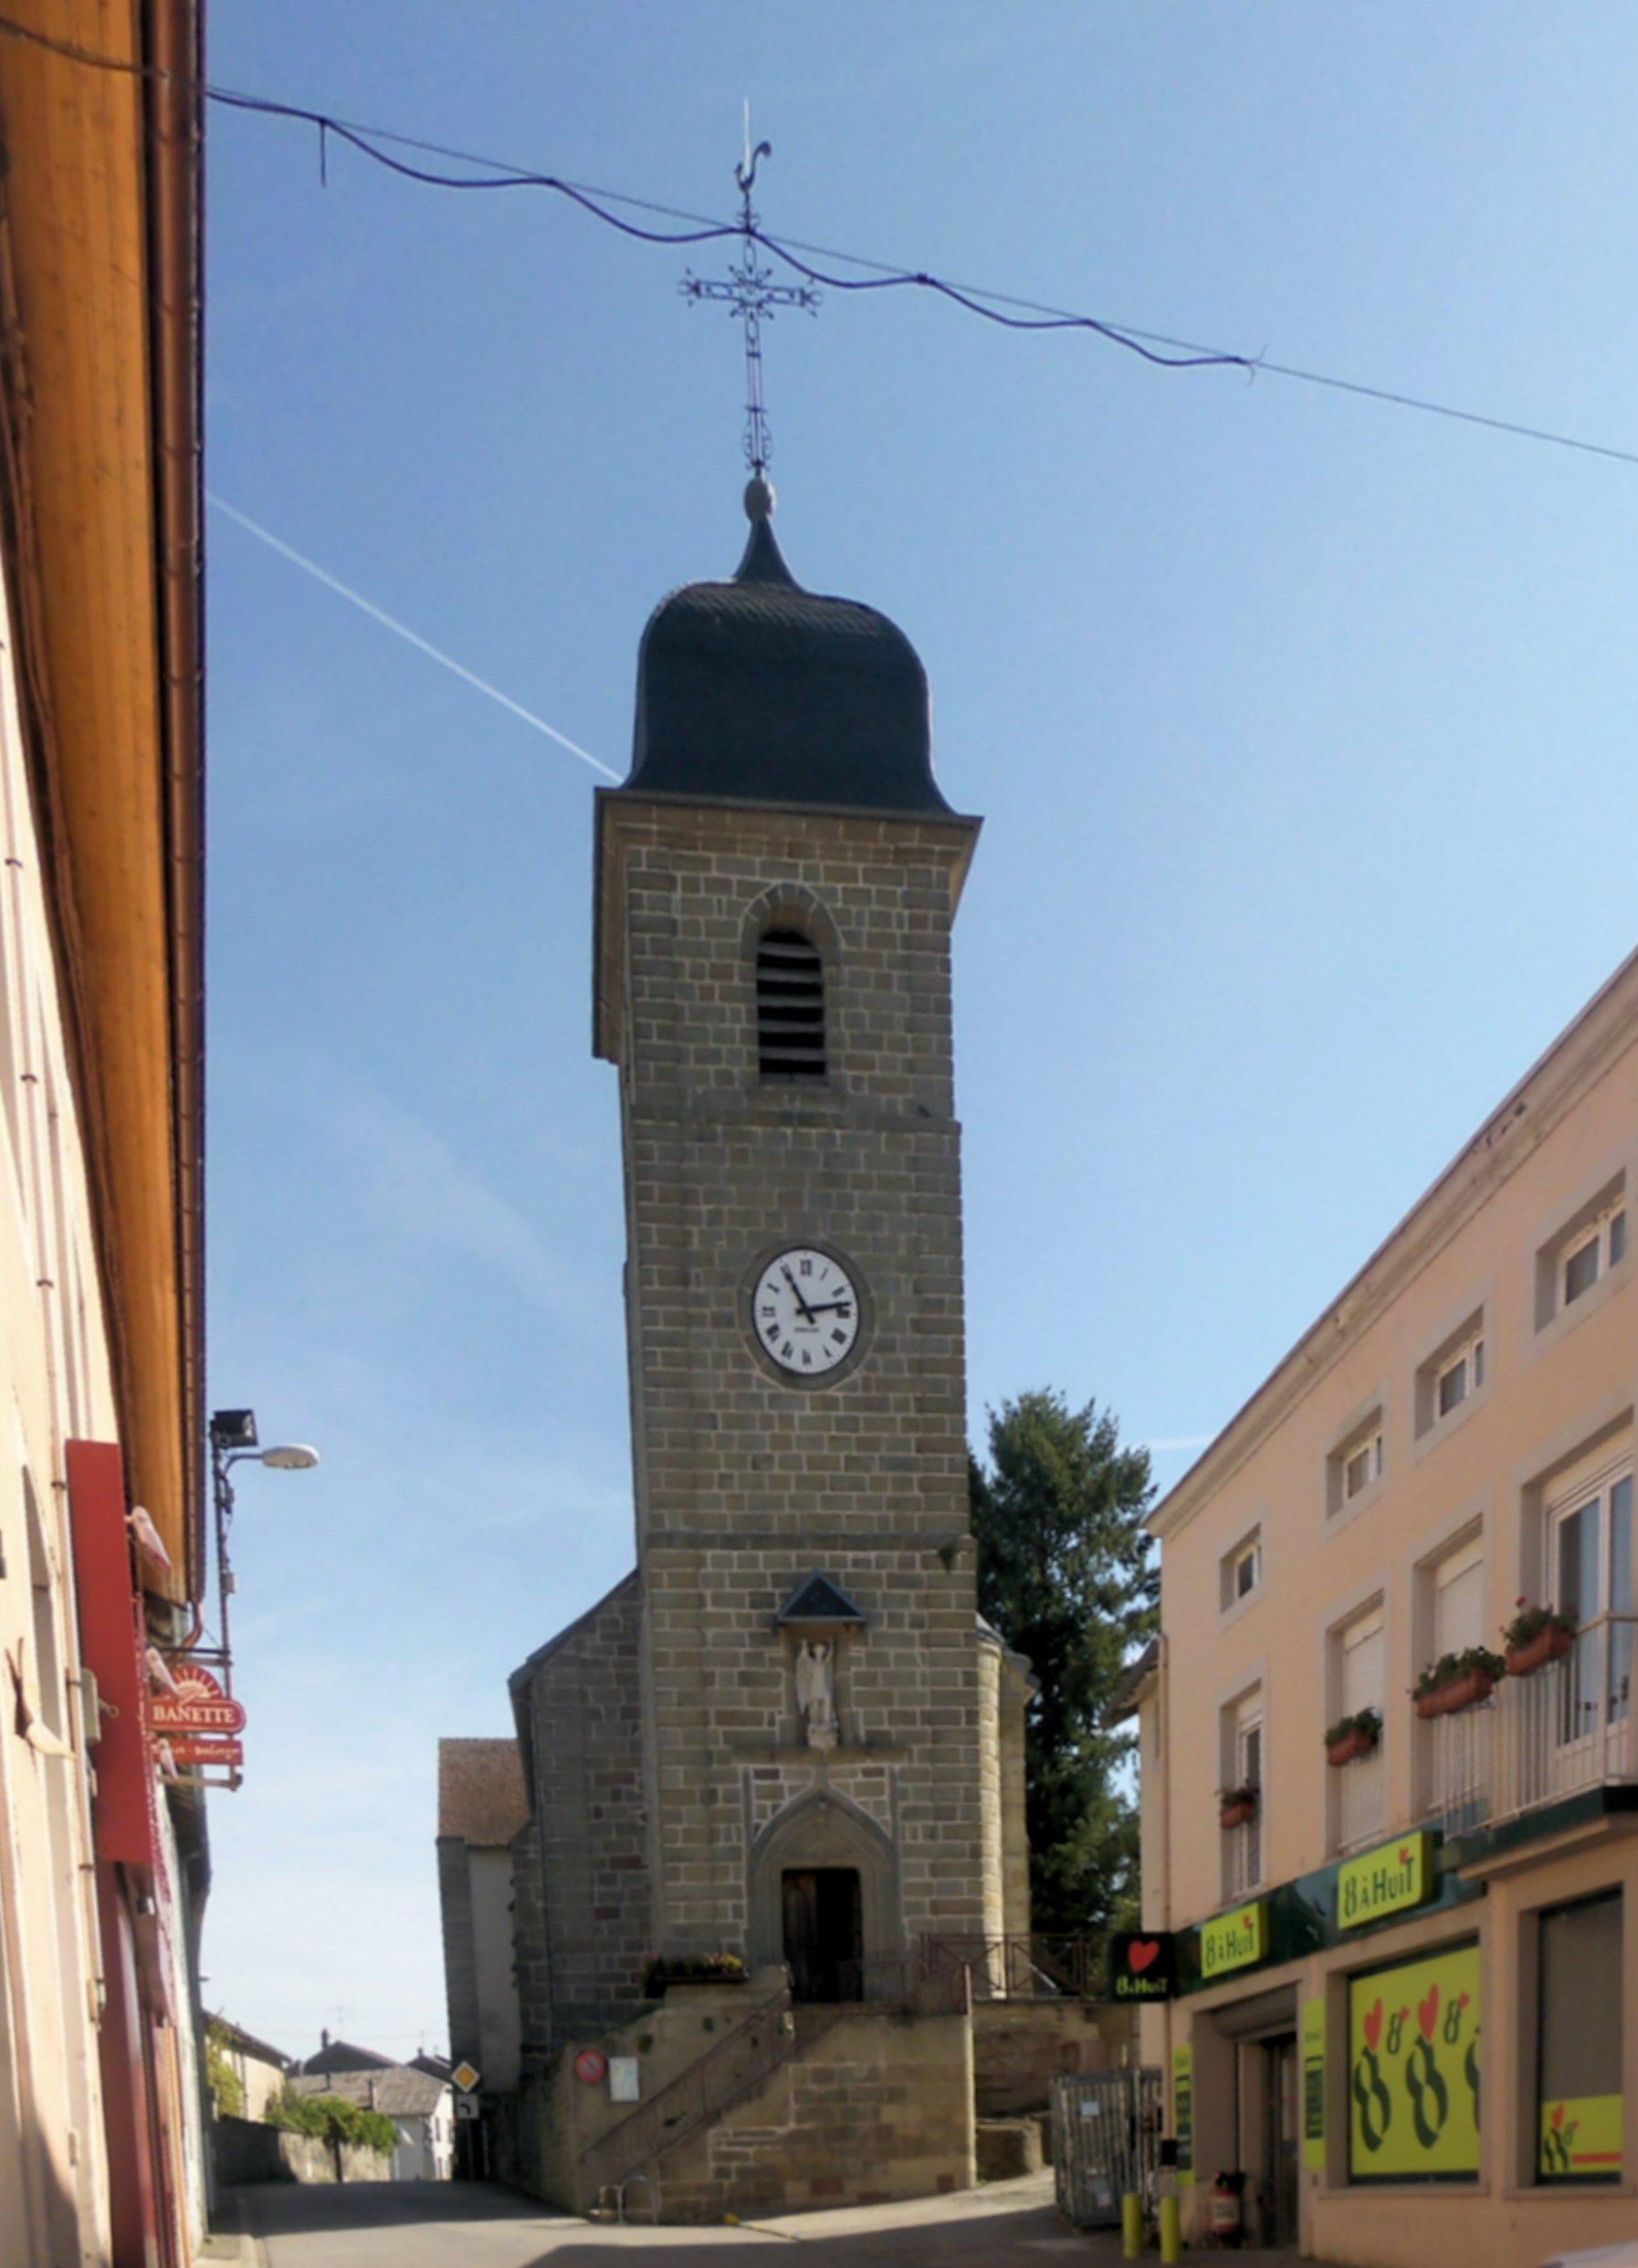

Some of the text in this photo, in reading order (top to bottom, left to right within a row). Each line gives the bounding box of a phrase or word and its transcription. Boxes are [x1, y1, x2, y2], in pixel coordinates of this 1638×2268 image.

[153, 1706, 235, 1723] BANETTE
[1345, 1874, 1358, 1917] 8
[1206, 1934, 1215, 1969] 8
[1116, 1975, 1129, 1996] 8
[1387, 2012, 1402, 2055] 8
[1444, 1999, 1462, 2044] 8
